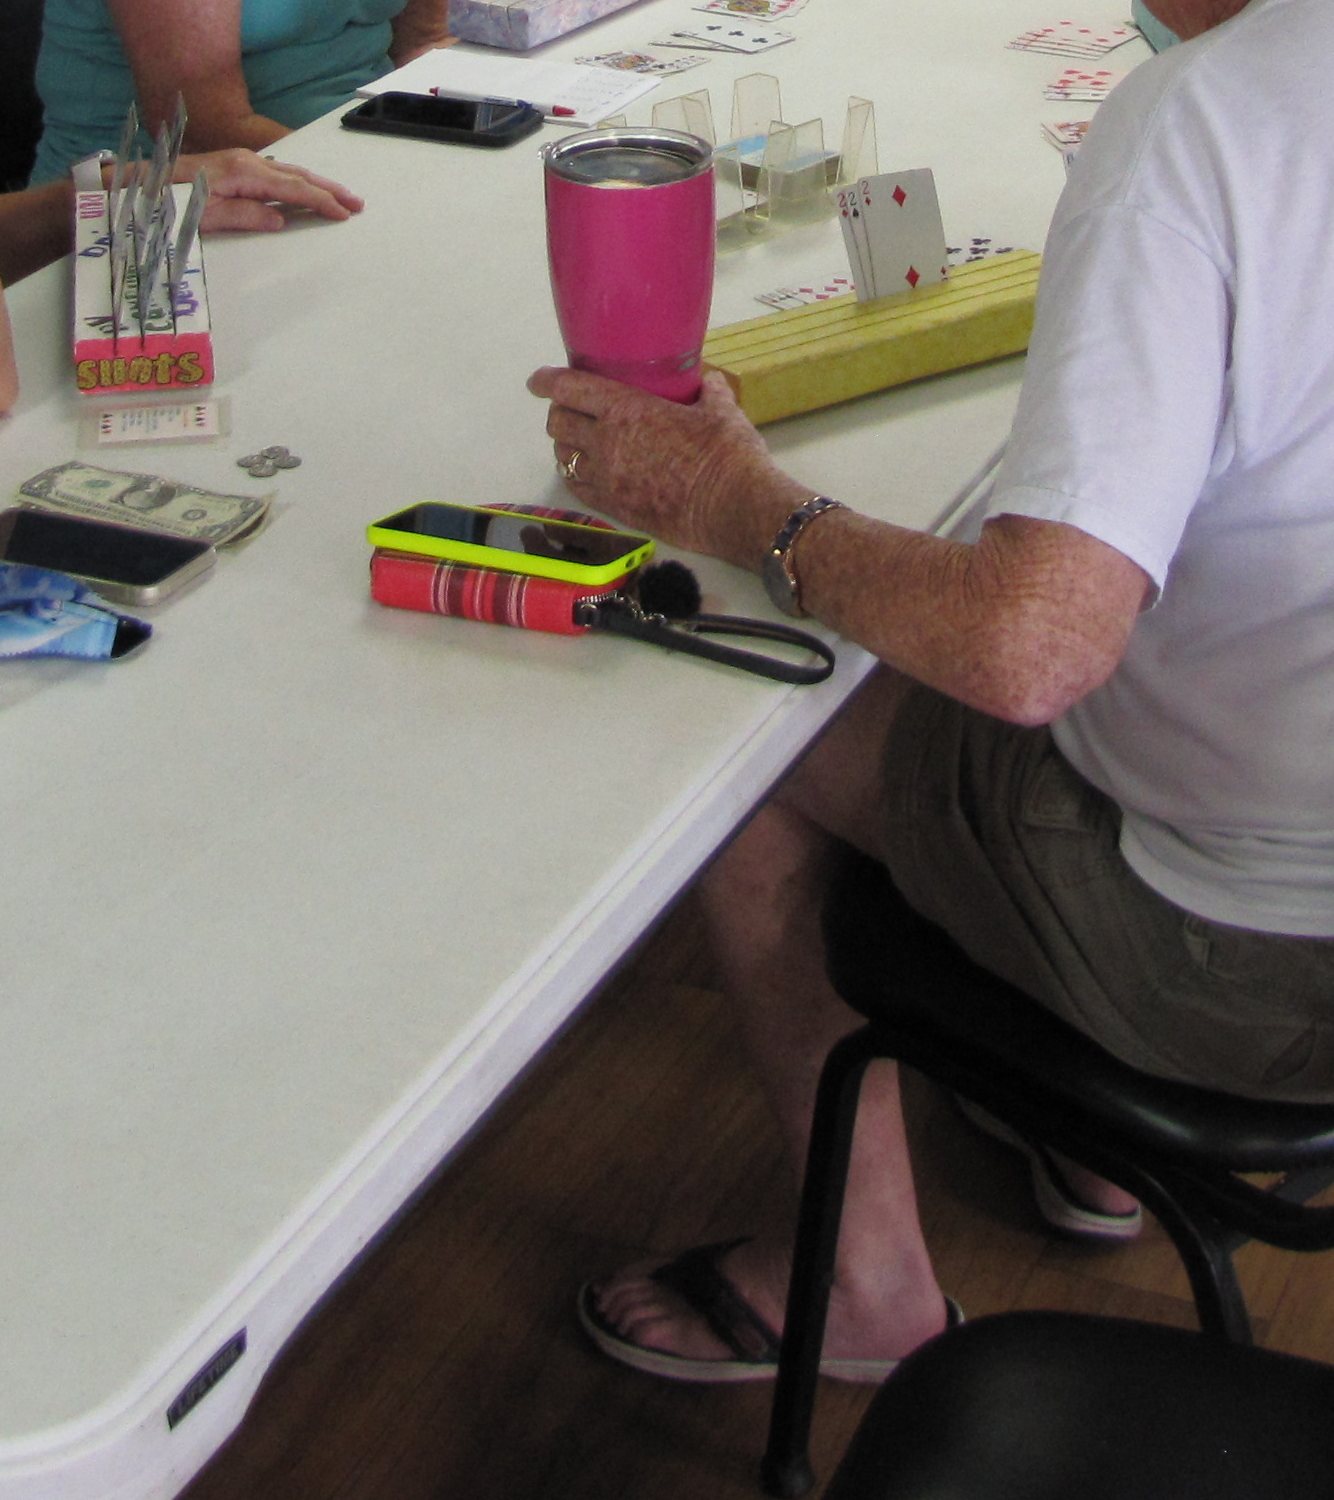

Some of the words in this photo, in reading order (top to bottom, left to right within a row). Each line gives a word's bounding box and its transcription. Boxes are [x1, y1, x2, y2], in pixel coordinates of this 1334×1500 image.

[837, 192, 847, 208] 2
[848, 191, 857, 206] 2
[861, 180, 870, 195] 2
